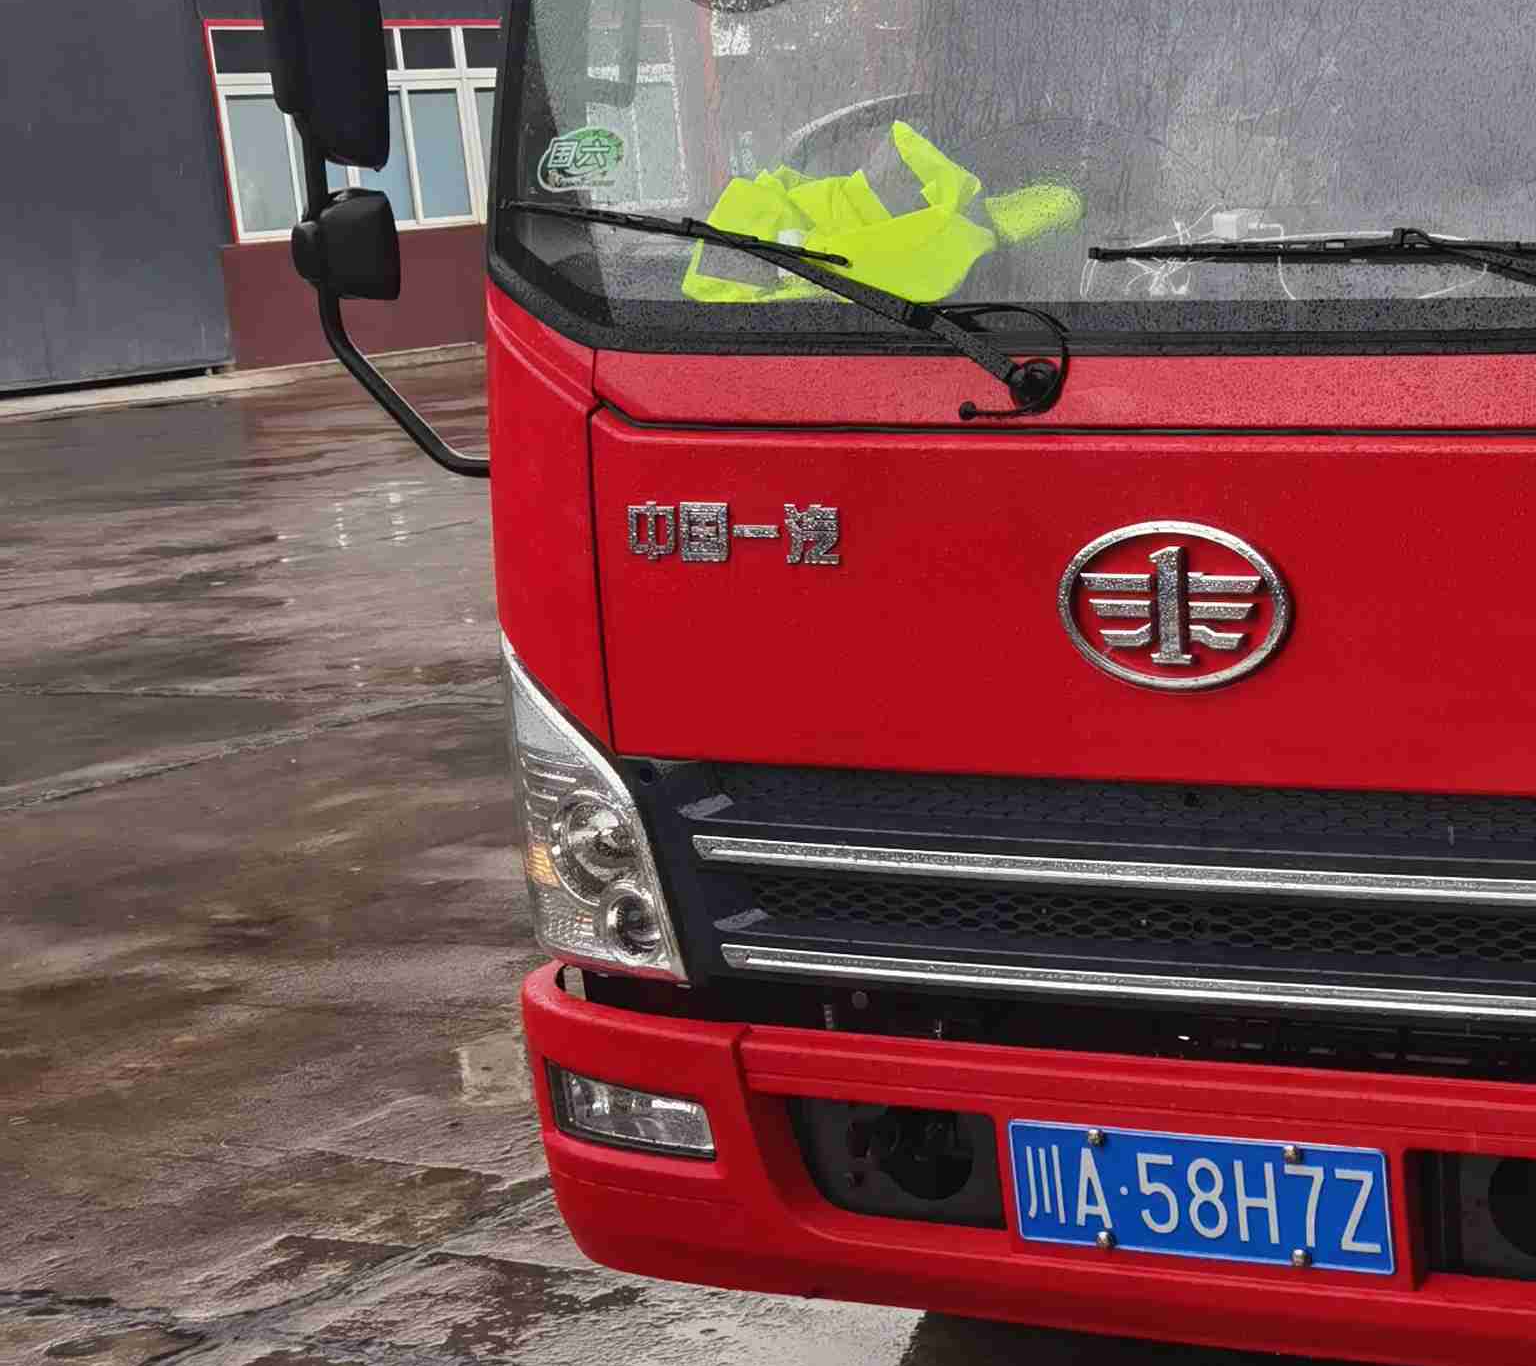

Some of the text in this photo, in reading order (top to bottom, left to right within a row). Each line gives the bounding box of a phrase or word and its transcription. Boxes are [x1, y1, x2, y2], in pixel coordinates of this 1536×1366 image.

[546, 138, 610, 169] 国六
[627, 500, 840, 564] 中国一汽
